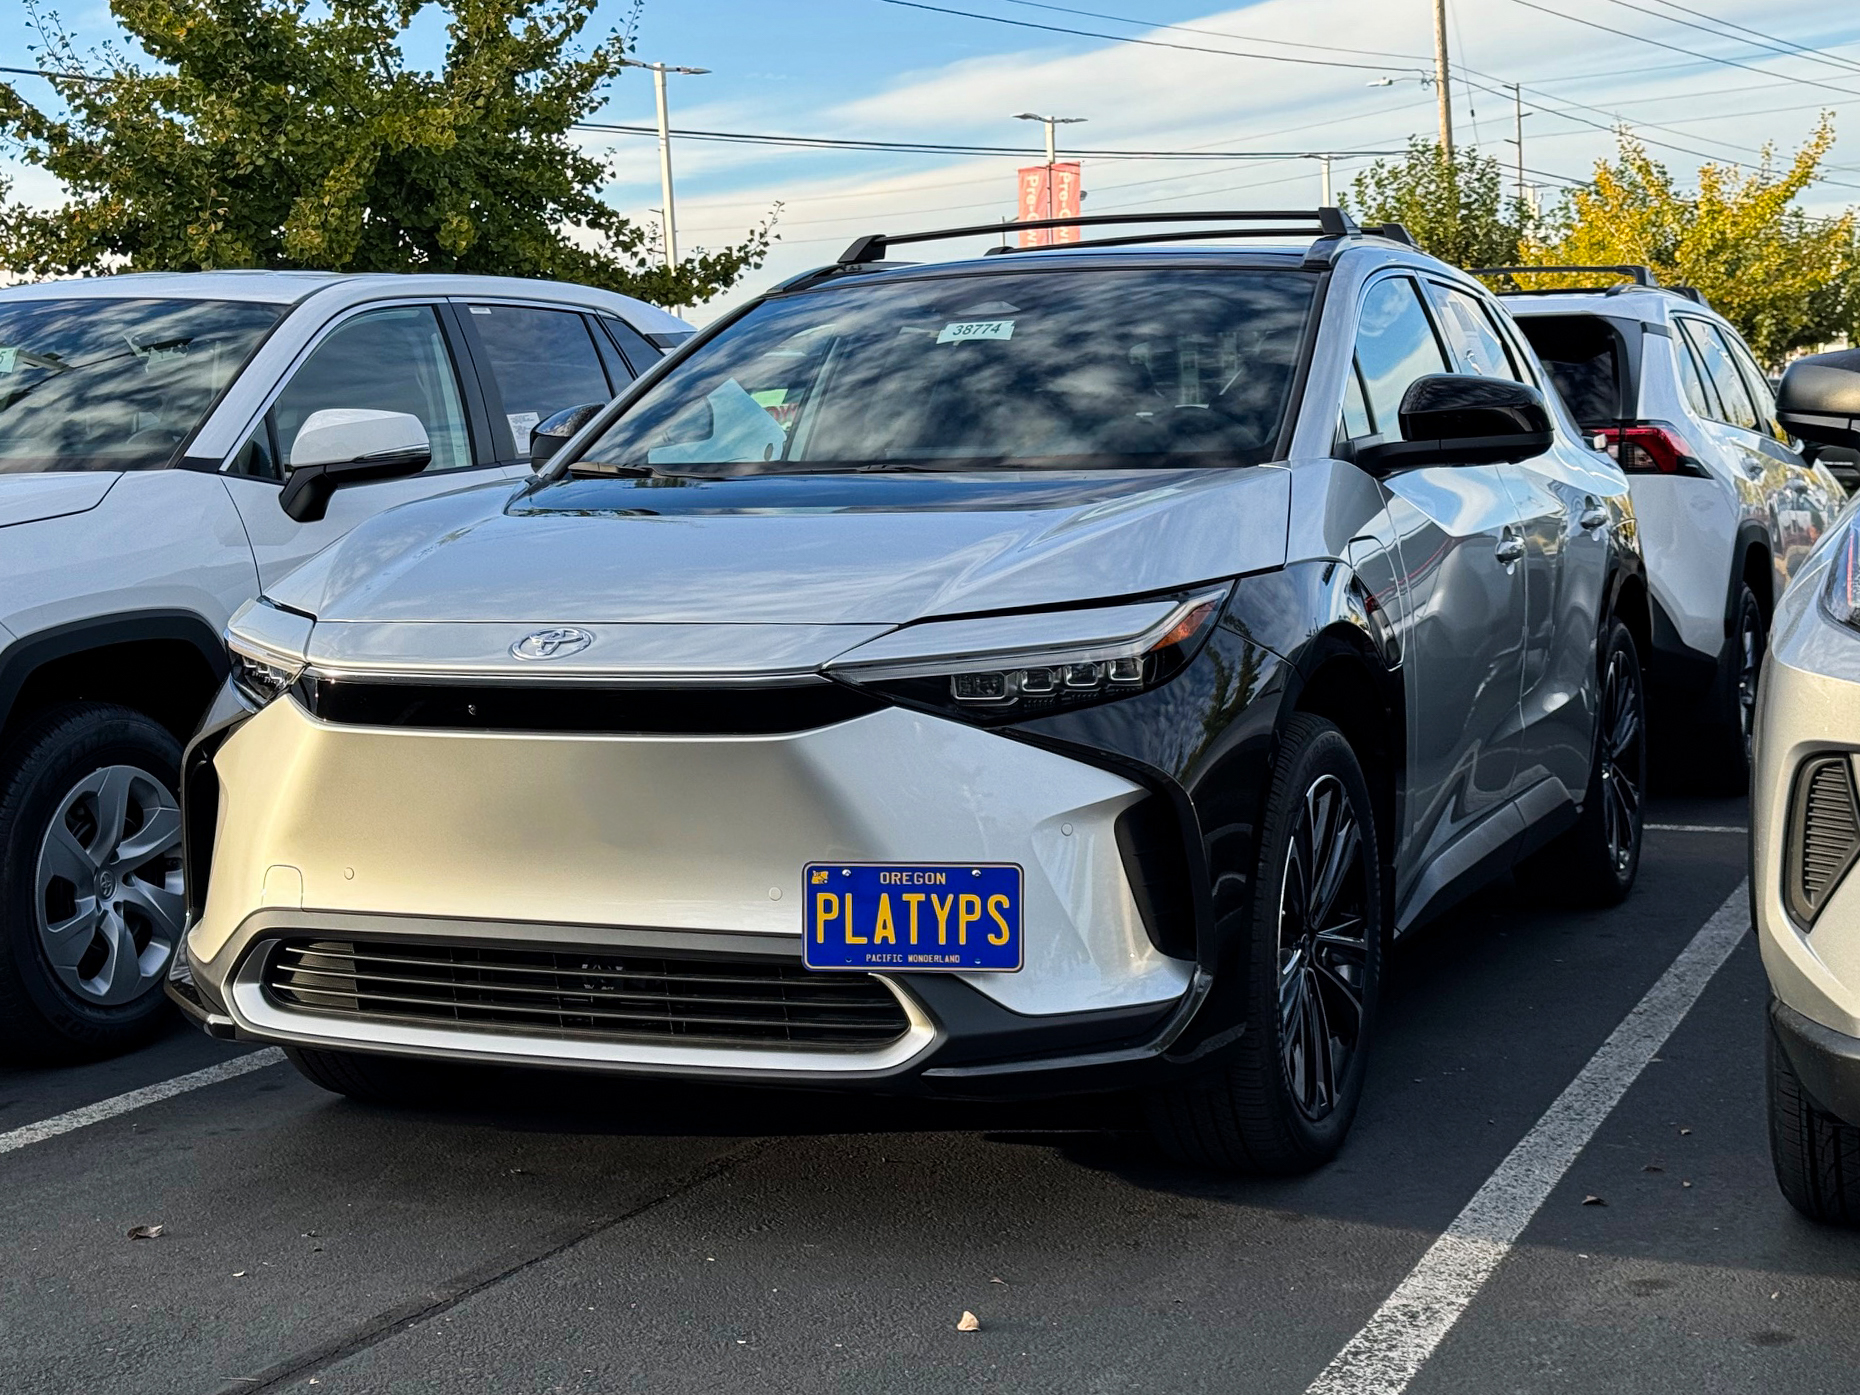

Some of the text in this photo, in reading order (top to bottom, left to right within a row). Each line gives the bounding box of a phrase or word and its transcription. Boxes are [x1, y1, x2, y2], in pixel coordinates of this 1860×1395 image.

[952, 323, 1002, 336] 38774
[880, 872, 946, 885] OREGON
[816, 893, 1010, 945] PLATYPS
[866, 954, 960, 963] PACIFIC WONDERLAND
